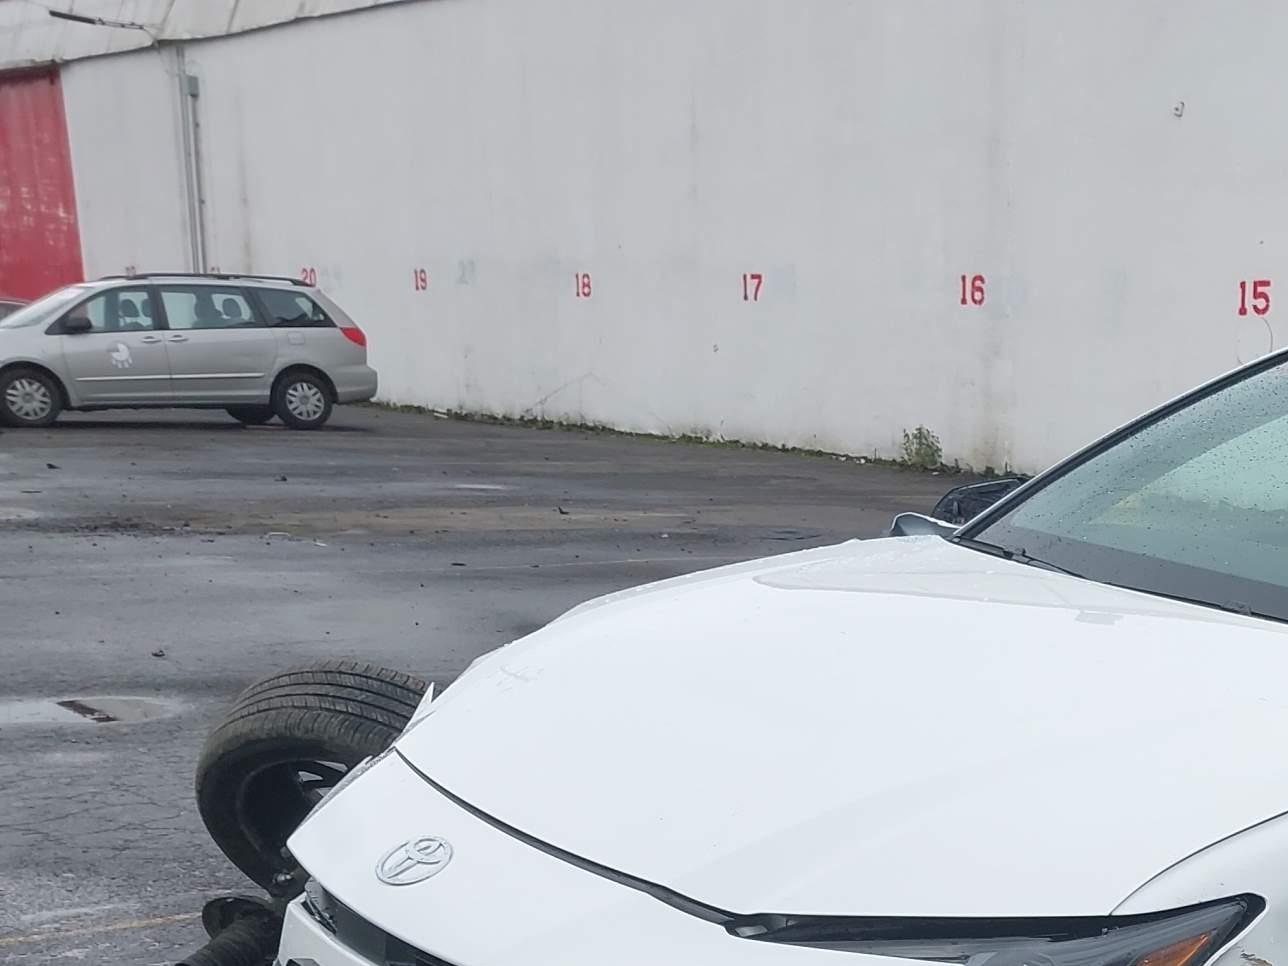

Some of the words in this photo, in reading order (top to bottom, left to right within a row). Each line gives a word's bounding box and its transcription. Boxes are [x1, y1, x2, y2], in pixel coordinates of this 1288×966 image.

[414, 269, 427, 291] 19
[576, 273, 592, 298] 18
[742, 273, 764, 301] 17
[960, 274, 986, 306] 16
[1237, 279, 1272, 317] 15
